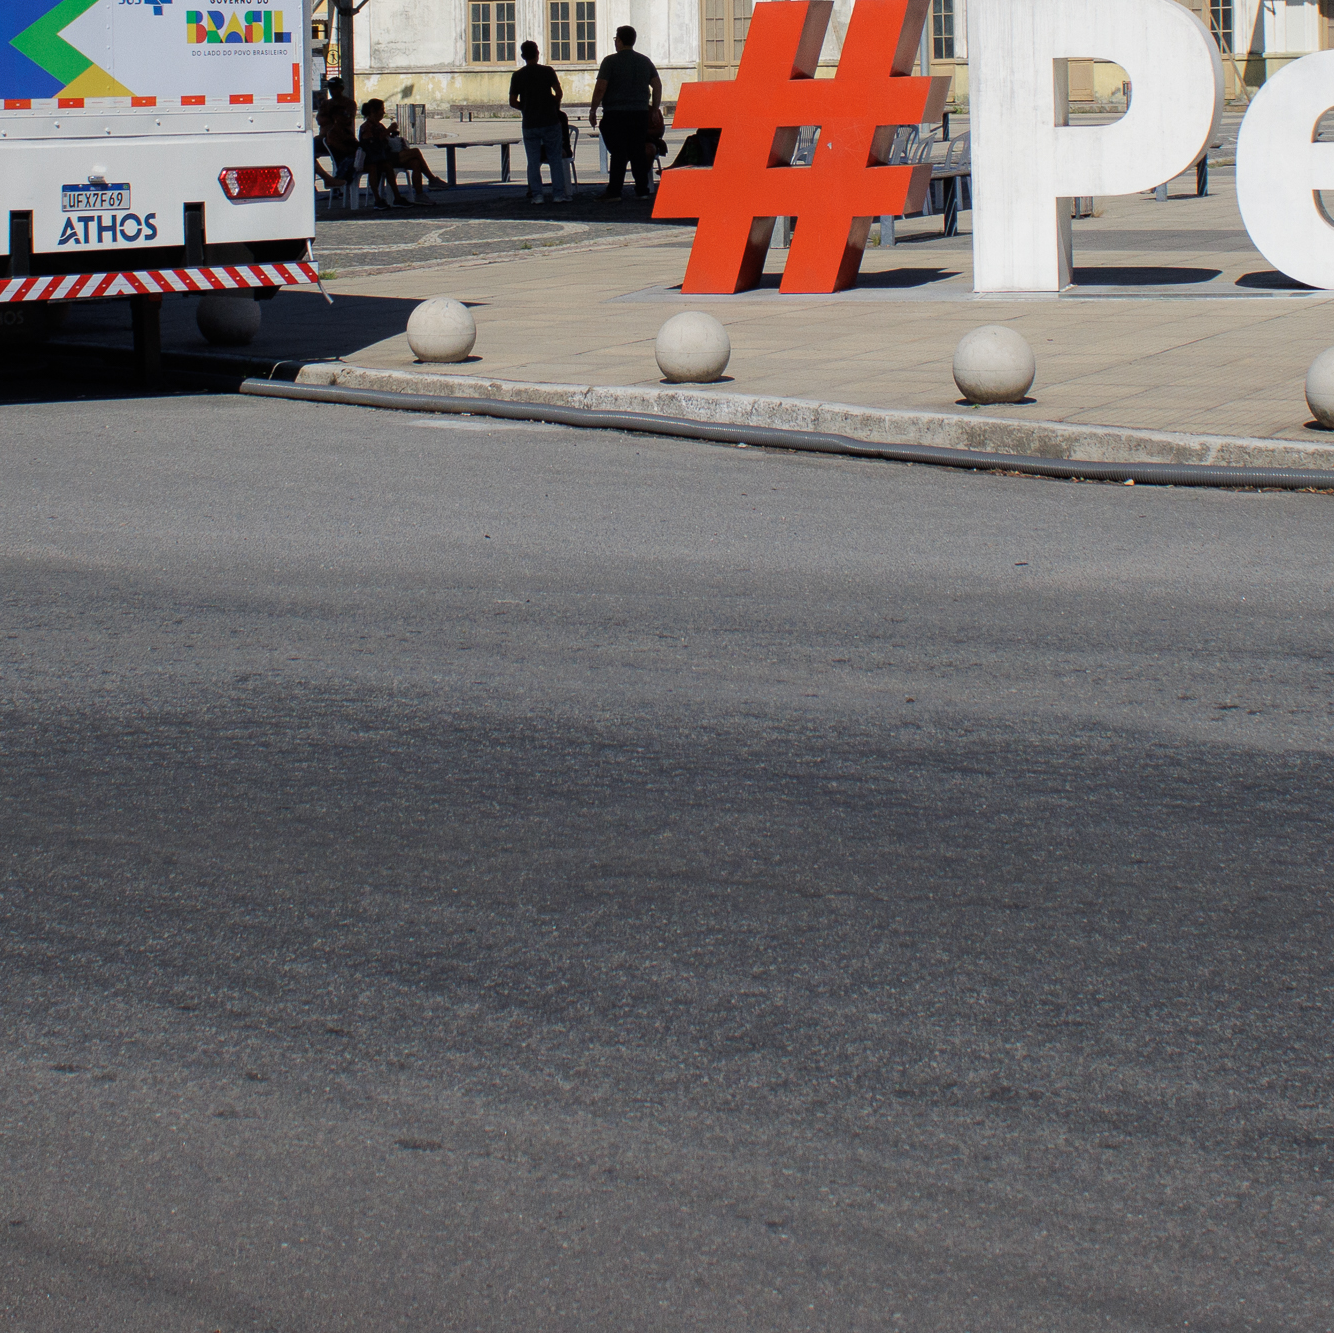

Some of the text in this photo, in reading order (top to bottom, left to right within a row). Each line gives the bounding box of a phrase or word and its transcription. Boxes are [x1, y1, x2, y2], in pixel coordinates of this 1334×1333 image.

[186, 10, 292, 44] BRASIL
[68, 192, 124, 208] UFX7F69
[57, 212, 158, 245] ATHOS
